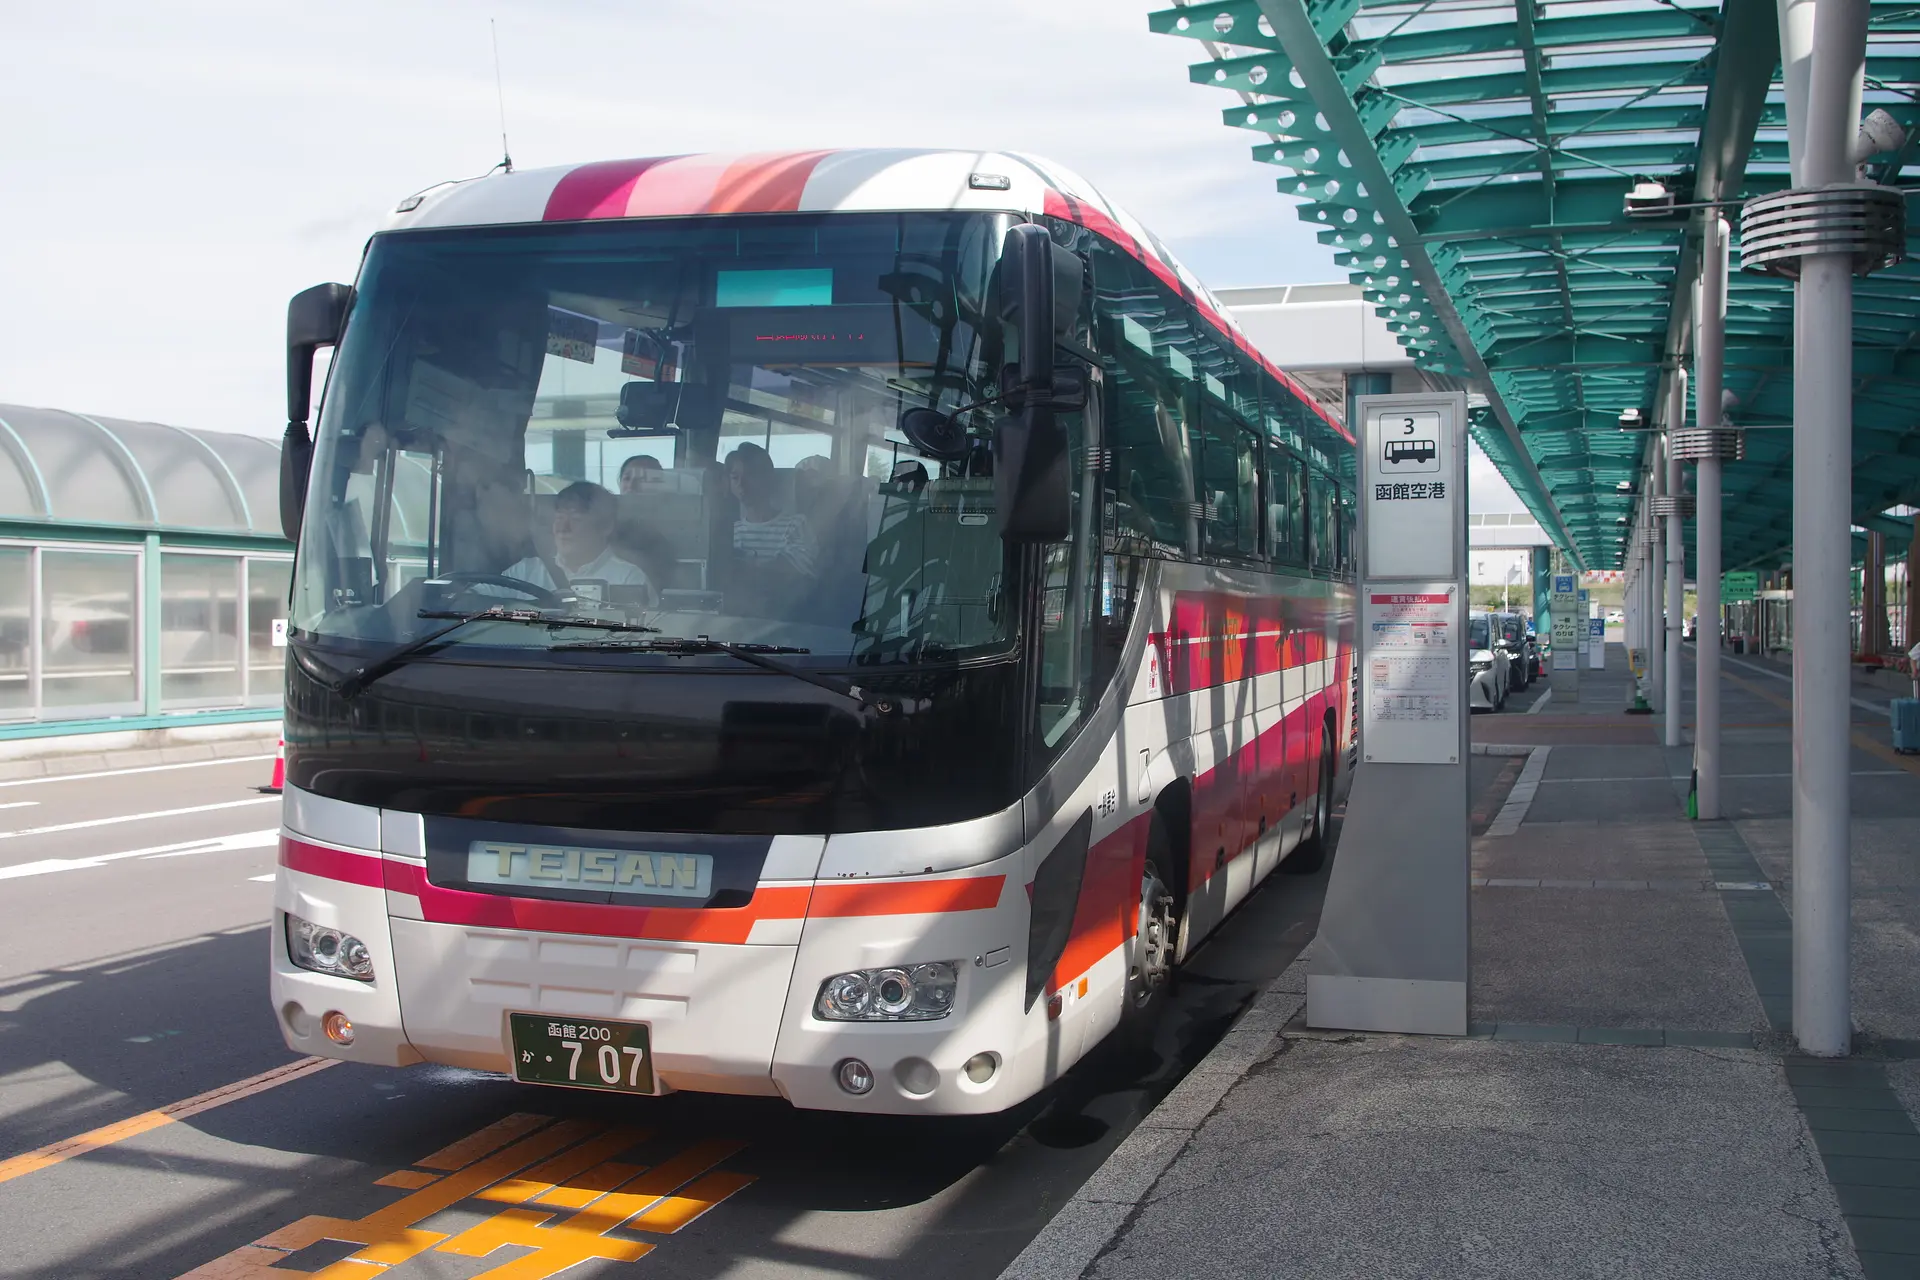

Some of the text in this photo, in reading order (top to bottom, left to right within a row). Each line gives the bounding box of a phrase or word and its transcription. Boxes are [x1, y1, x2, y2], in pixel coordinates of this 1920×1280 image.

[1404, 418, 1414, 434] 3
[1375, 482, 1445, 500] 函館空港
[485, 845, 698, 889] TEISAN
[522, 1050, 535, 1063] か
